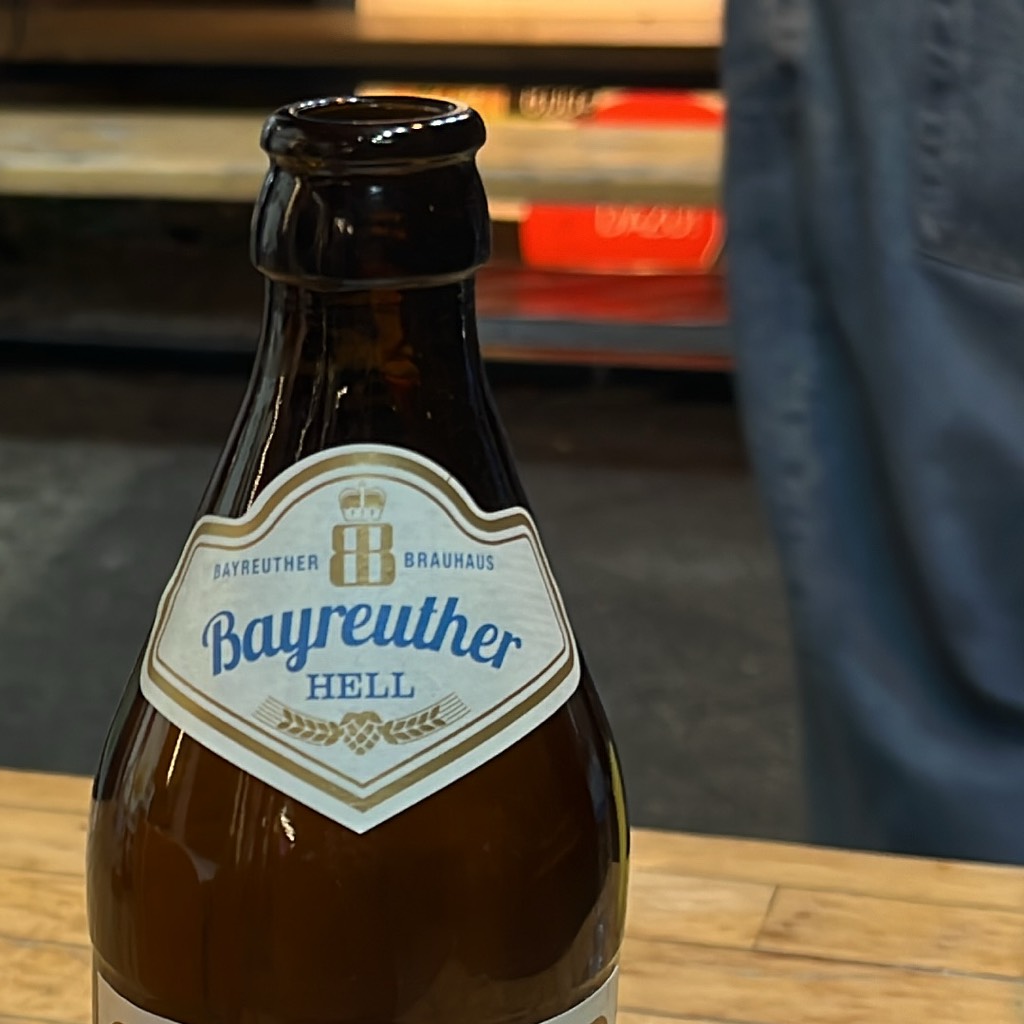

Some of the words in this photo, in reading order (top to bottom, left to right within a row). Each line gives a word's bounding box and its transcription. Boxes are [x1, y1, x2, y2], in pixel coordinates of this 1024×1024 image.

[213, 554, 319, 580] BAYREUTHER
[403, 551, 495, 571] BRAUHAUS
[202, 596, 522, 676] Bayreuther
[306, 672, 416, 701] HELL
